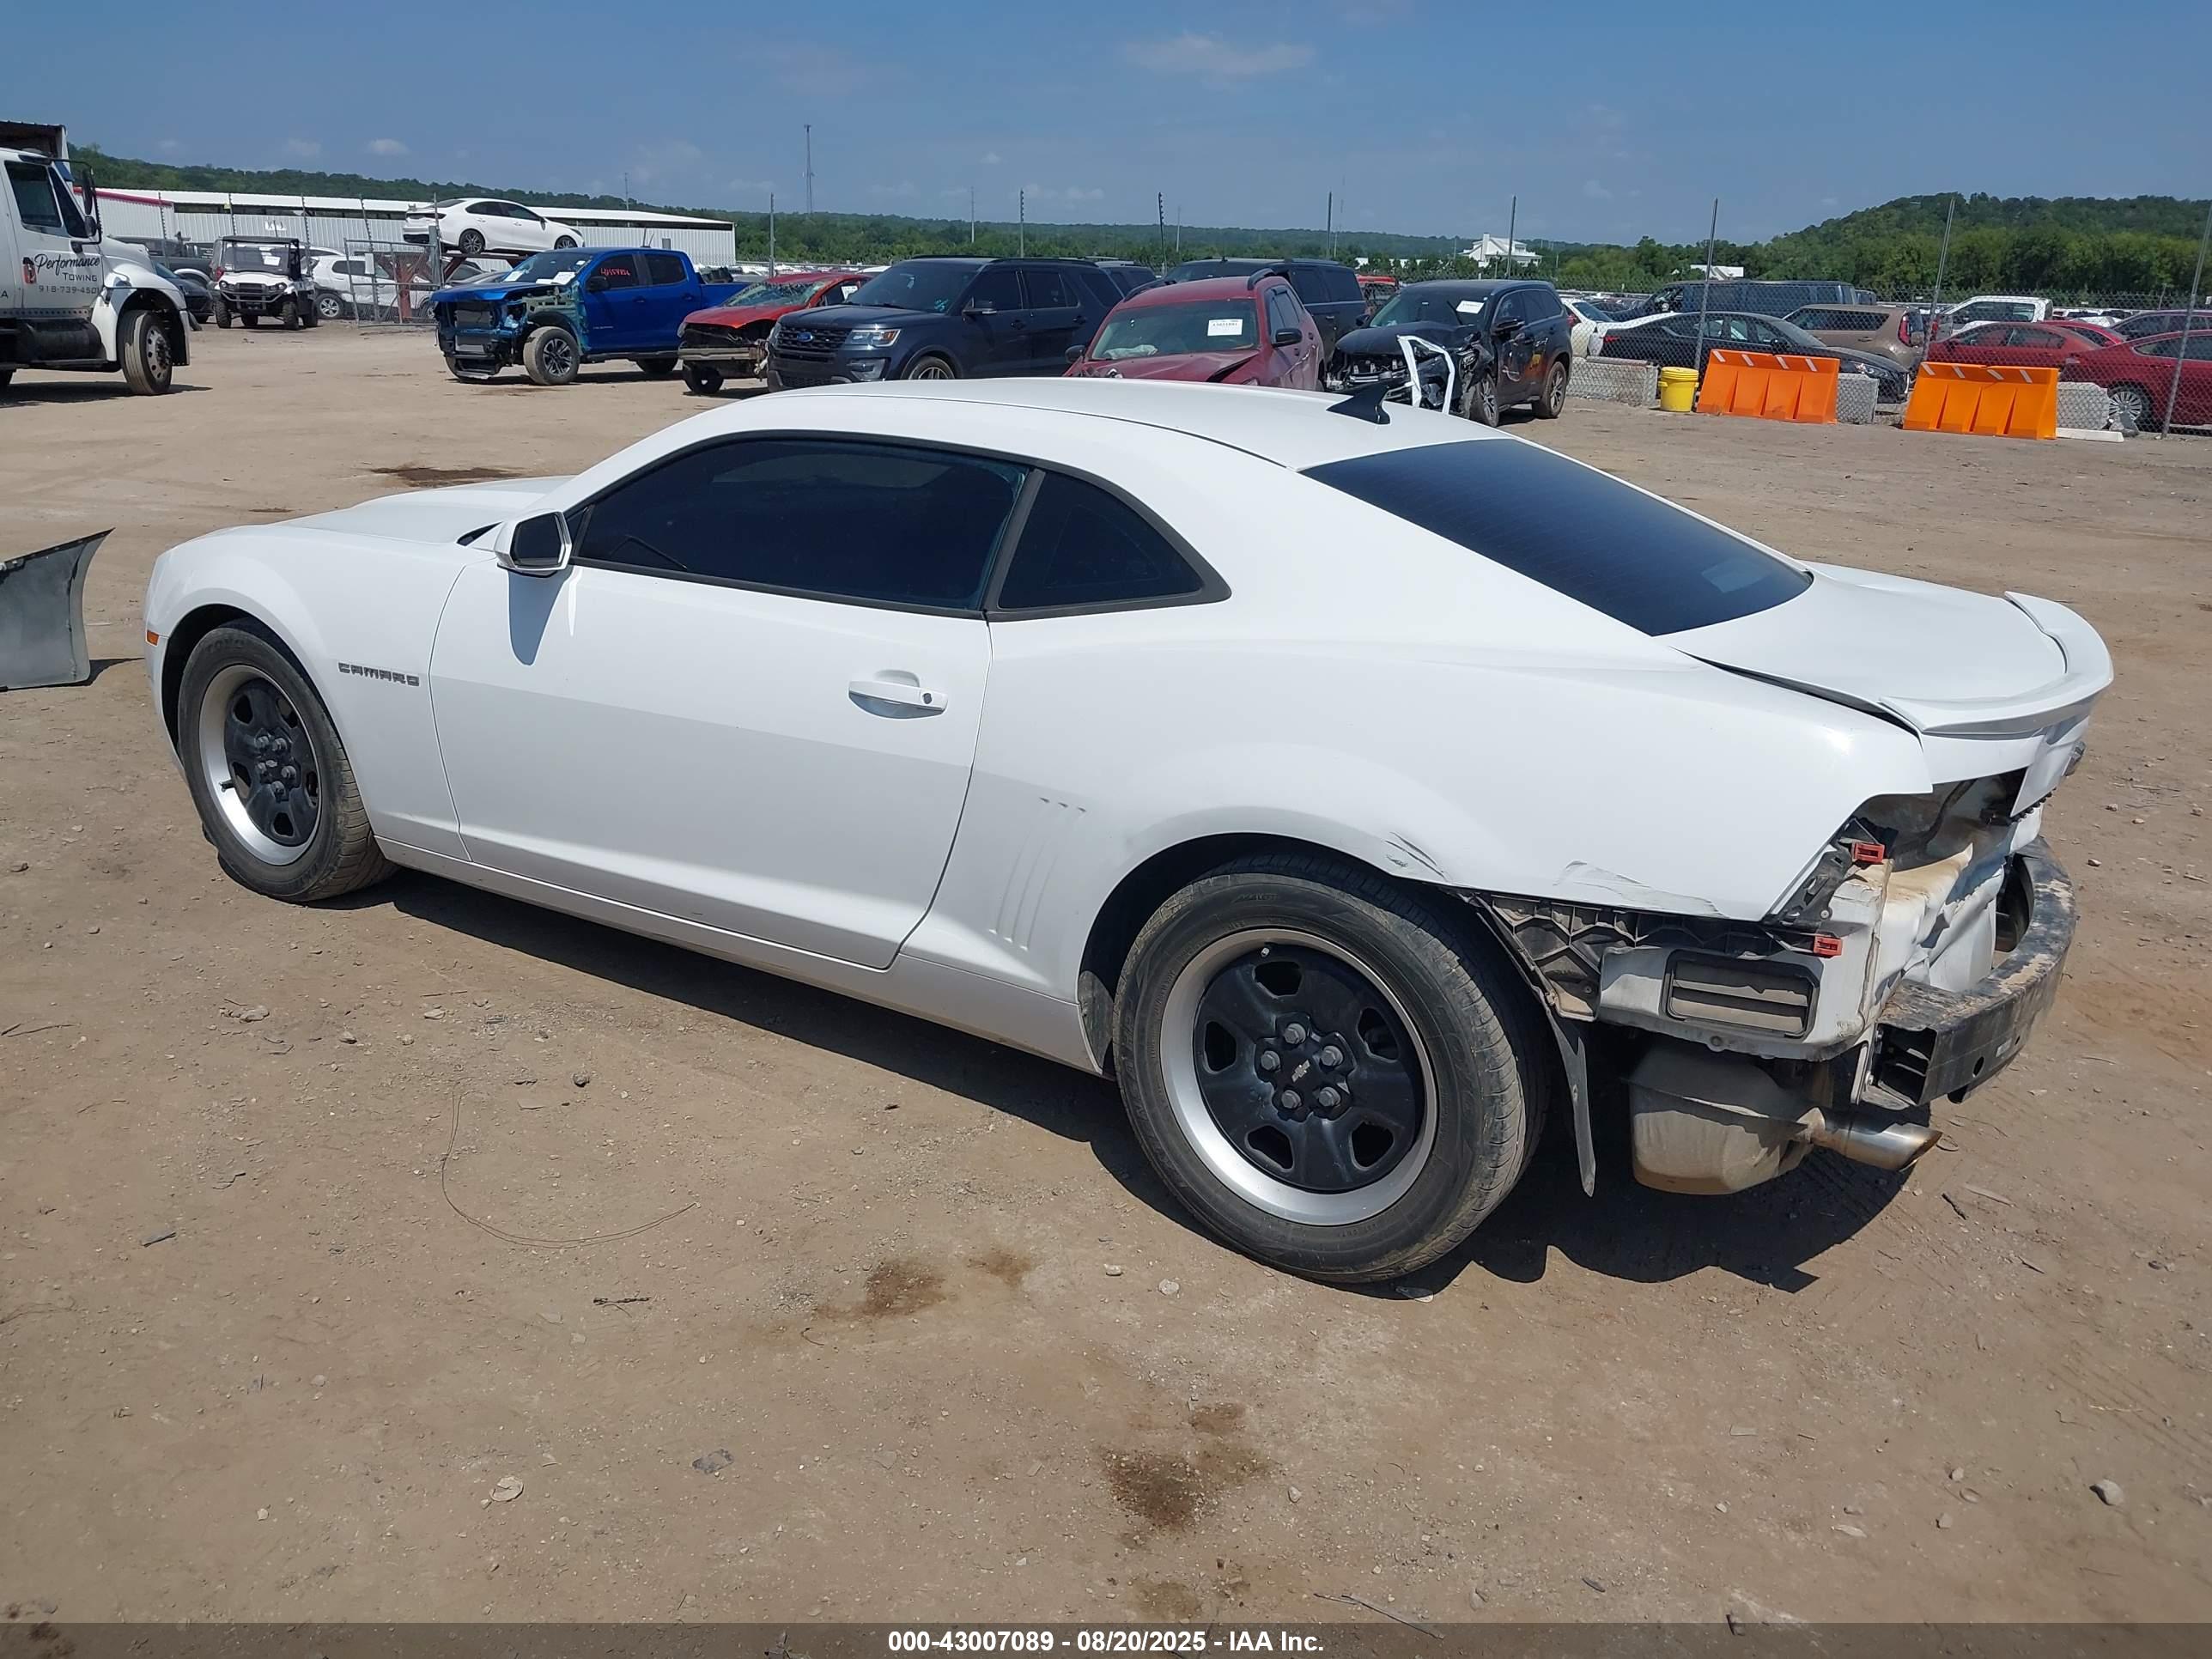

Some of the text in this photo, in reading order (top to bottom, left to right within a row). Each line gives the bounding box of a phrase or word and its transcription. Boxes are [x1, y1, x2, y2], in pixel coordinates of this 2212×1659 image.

[34, 253, 100, 276] Performance
[62, 272, 98, 282] TOWING
[338, 662, 420, 687] CAMARO
